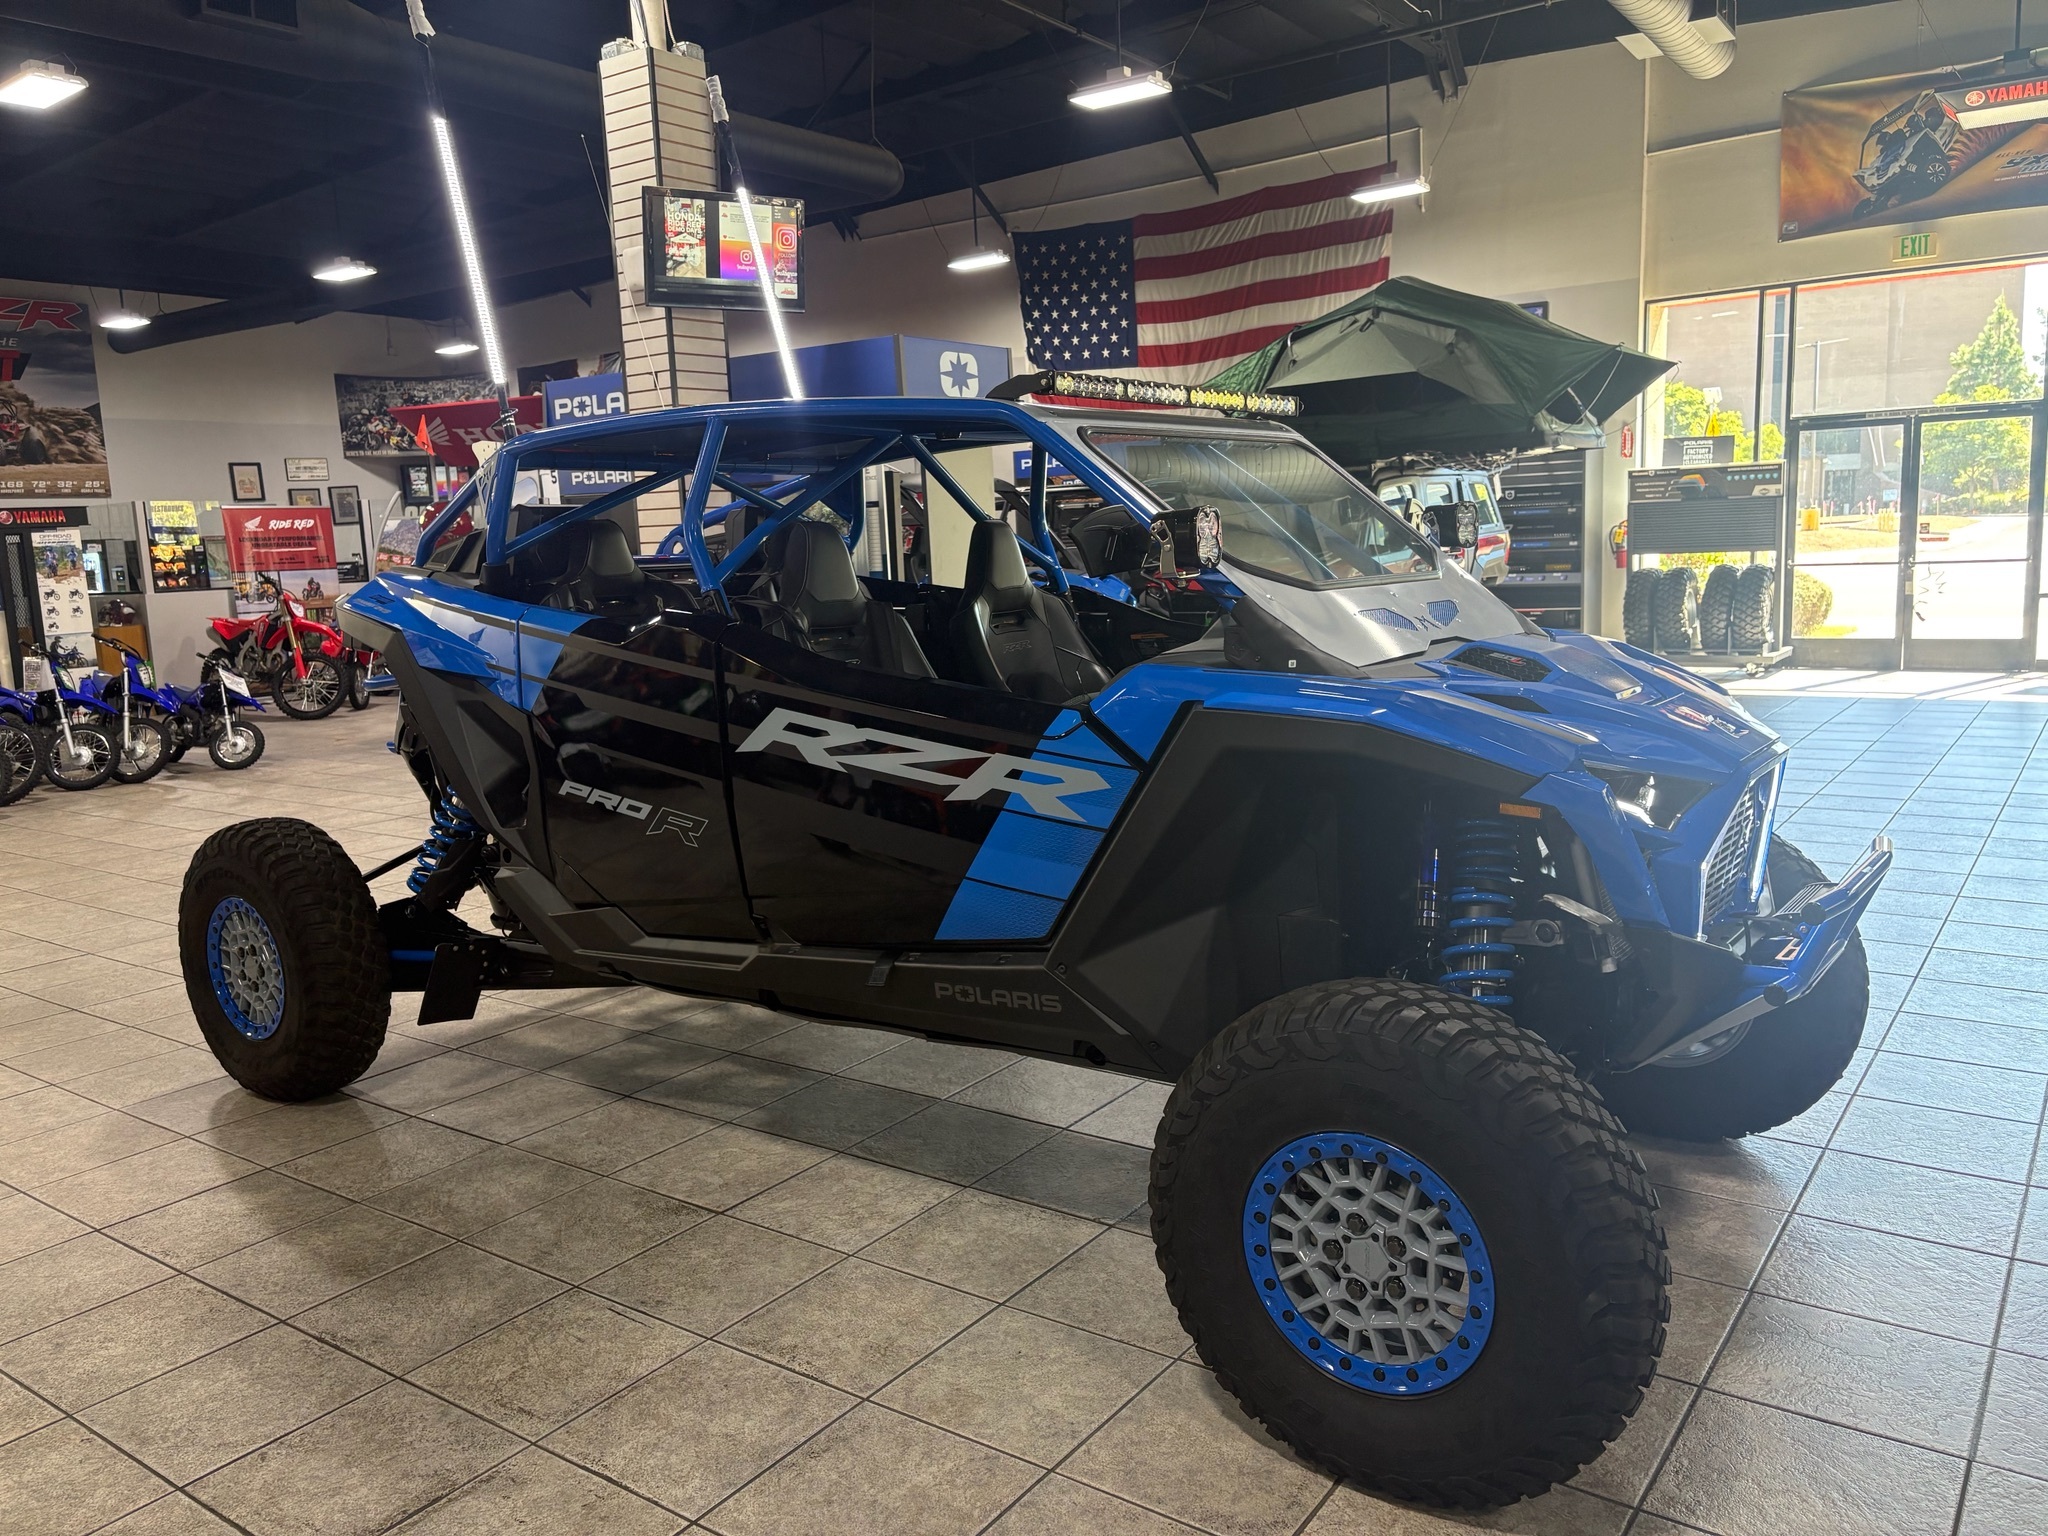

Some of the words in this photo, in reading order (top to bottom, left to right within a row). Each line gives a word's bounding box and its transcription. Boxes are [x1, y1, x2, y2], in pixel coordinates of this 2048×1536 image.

[1986, 80, 2048, 103] YAMAH
[667, 211, 701, 222] HONDA
[667, 219, 685, 227] RIDE
[1901, 234, 1930, 257] EXIT
[554, 391, 625, 420] POLA
[571, 470, 632, 485] POLARI
[14, 509, 66, 523] YAMAHA
[268, 519, 292, 530] RIDE
[293, 518, 315, 530] RED
[735, 707, 1112, 822] RZR
[558, 779, 653, 820] PRO
[646, 806, 709, 848] R
[934, 981, 1062, 1013] POLARIS
